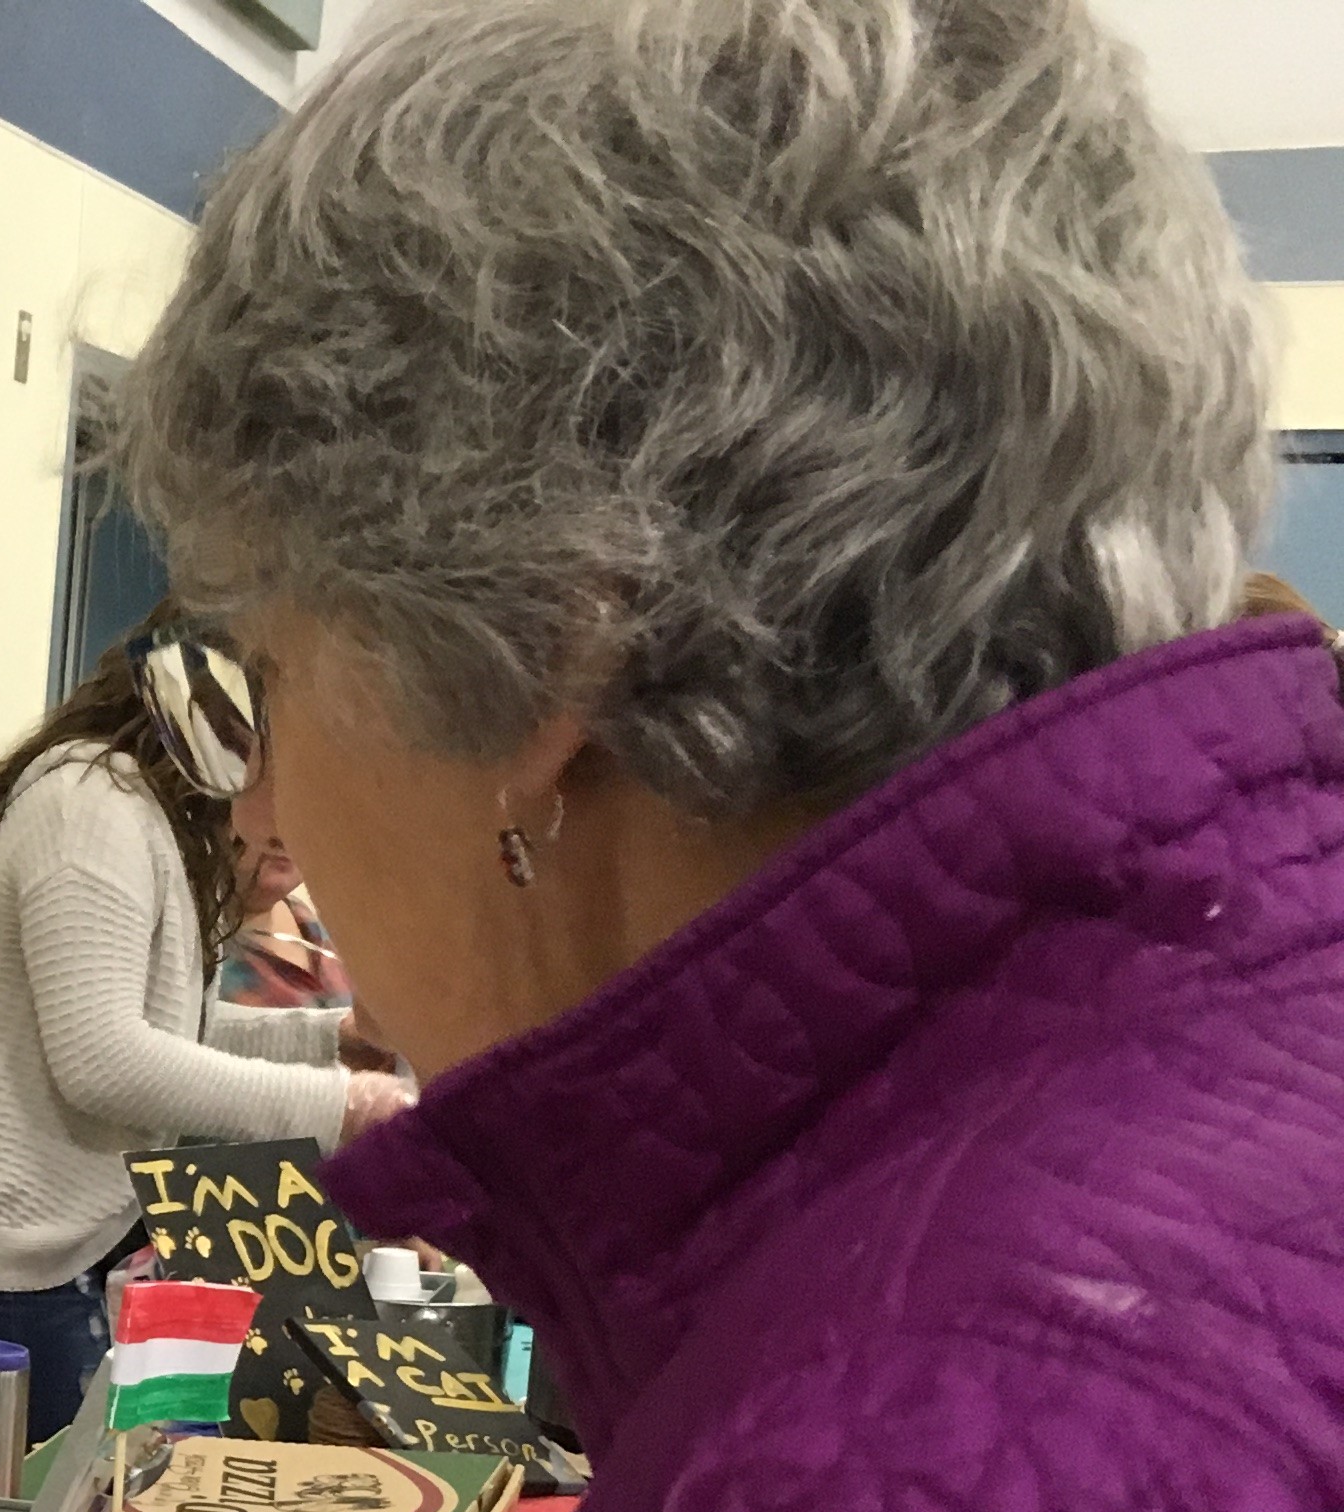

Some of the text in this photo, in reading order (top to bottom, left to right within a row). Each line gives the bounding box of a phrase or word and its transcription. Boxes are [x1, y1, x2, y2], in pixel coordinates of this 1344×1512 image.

[277, 1160, 325, 1208] A
[225, 1213, 360, 1289] DOG
[347, 1360, 506, 1409] A CAT
